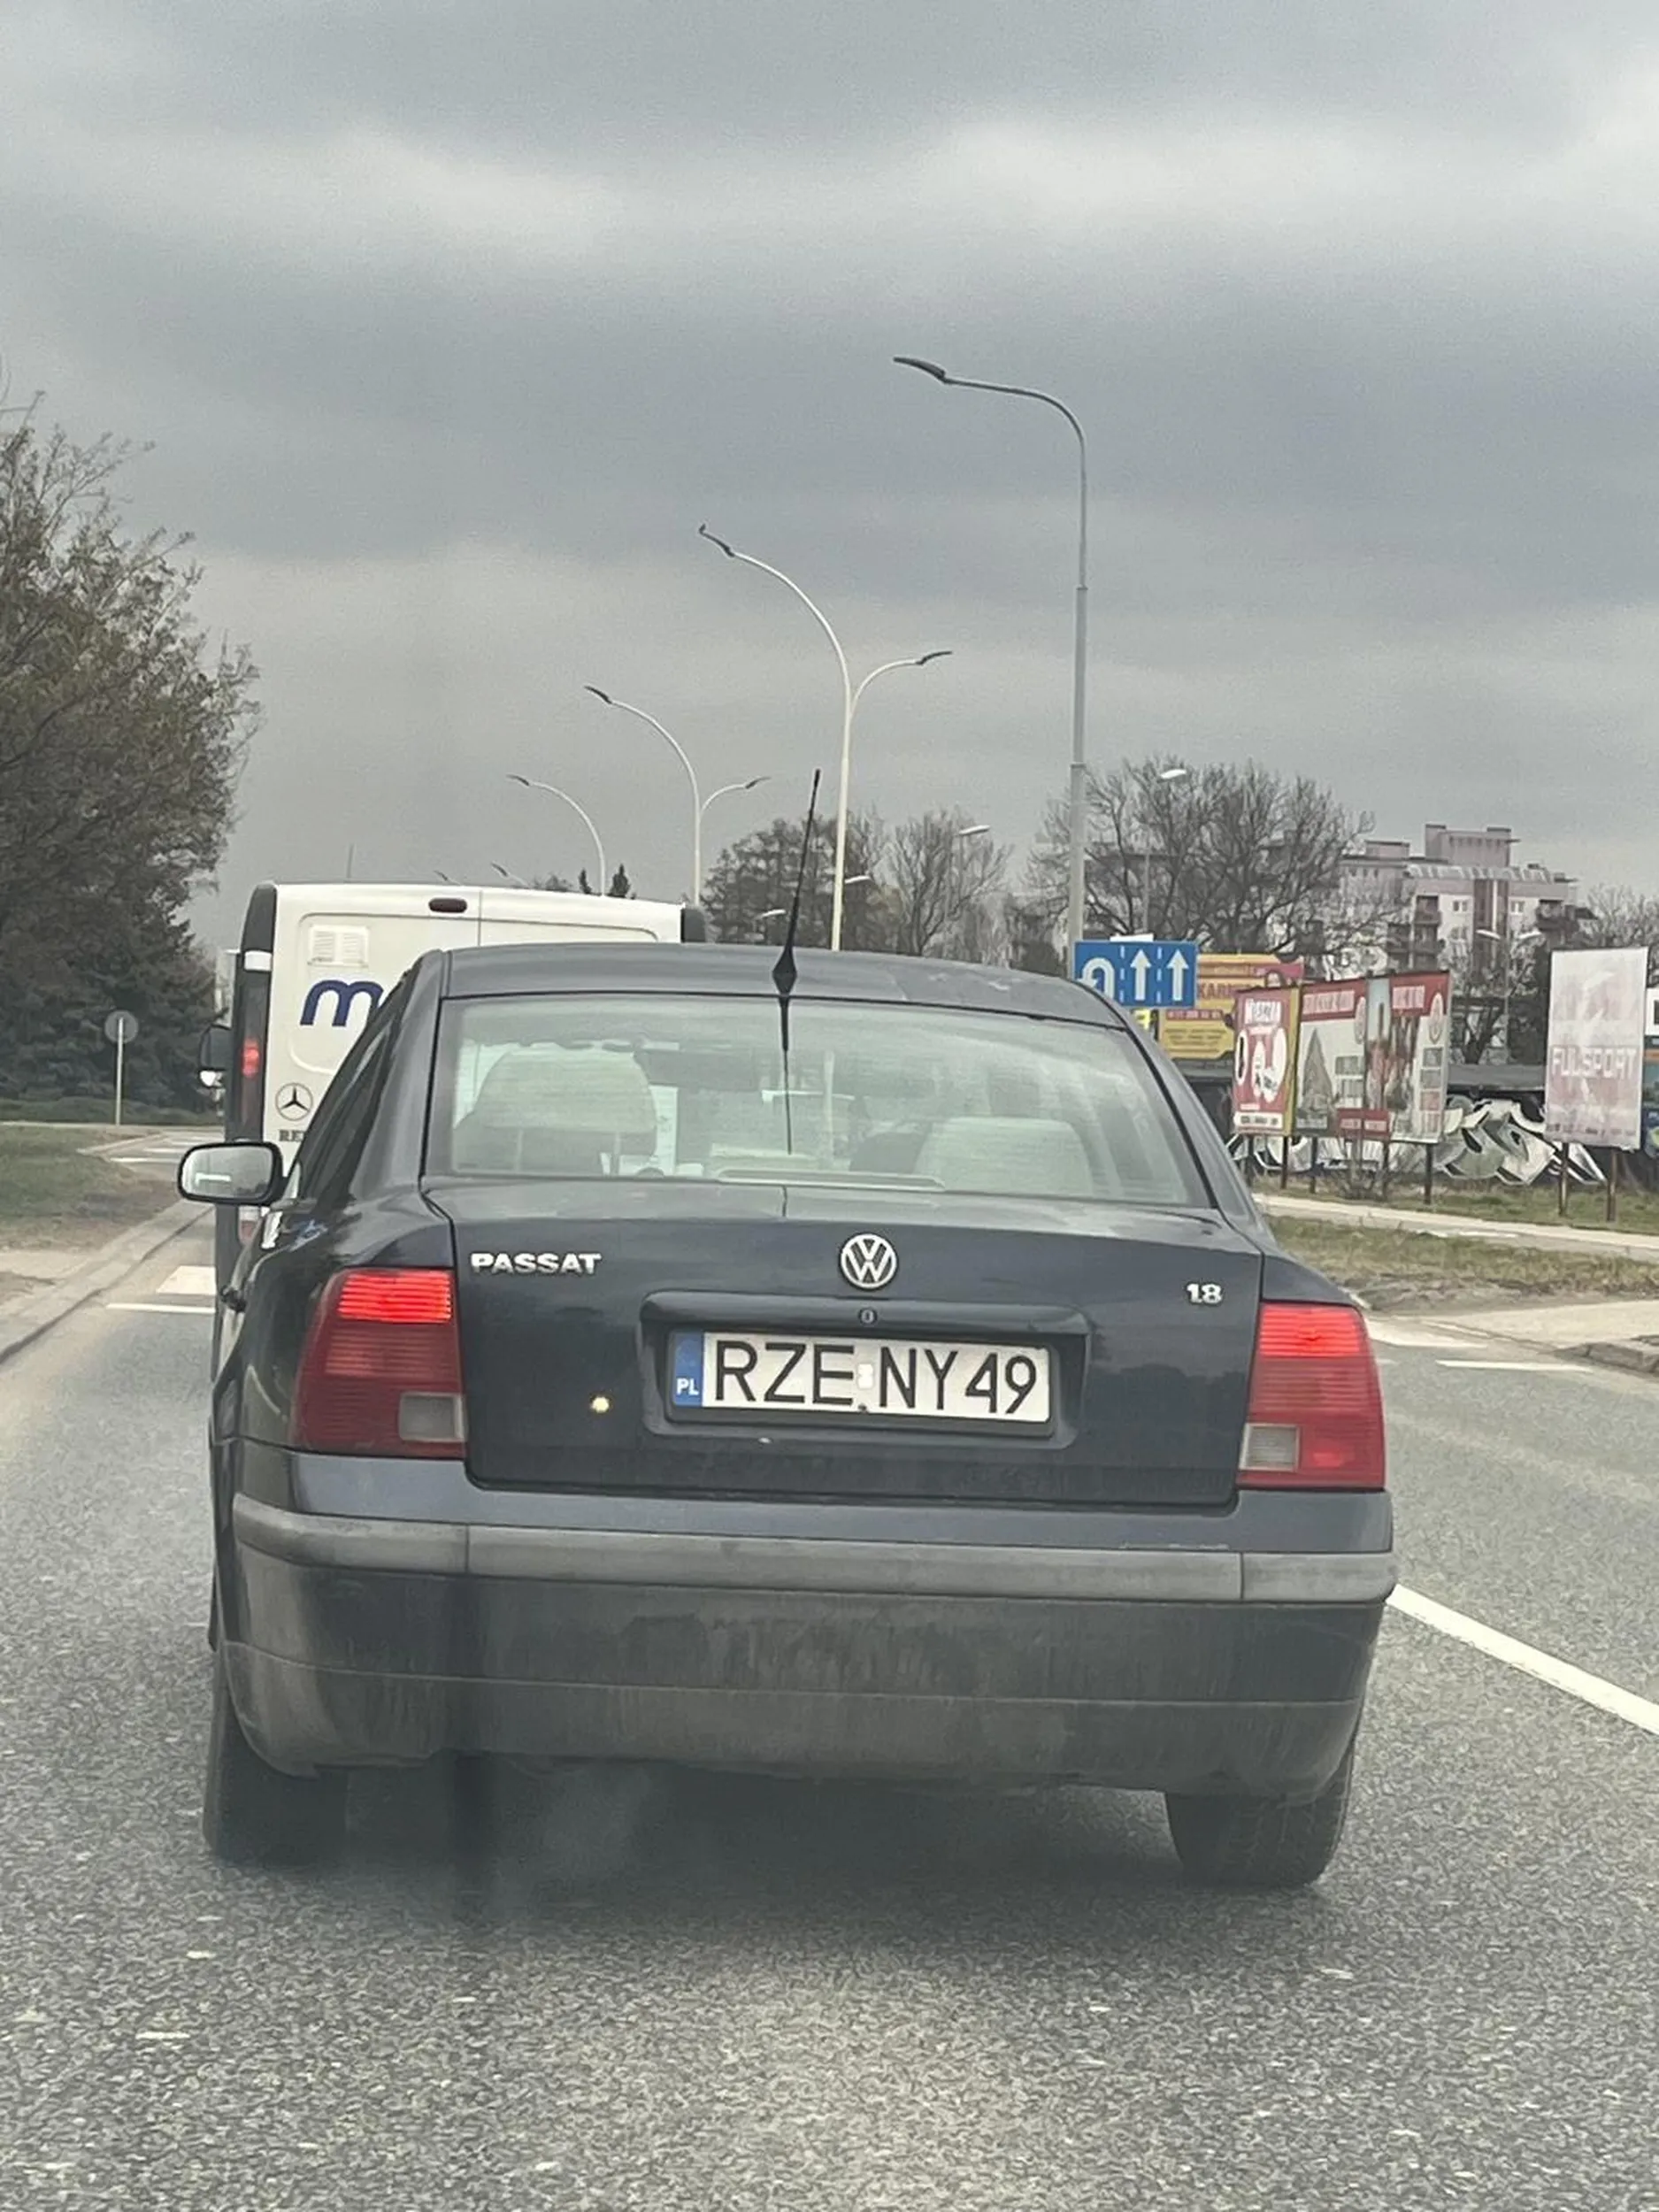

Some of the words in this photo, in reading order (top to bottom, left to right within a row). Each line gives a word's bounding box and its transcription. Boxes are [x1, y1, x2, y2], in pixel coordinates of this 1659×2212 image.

[279, 1129, 306, 1141] RE
[471, 1253, 602, 1274] PASSAT
[715, 1340, 855, 1406] RZE
[879, 1346, 1036, 1414] NY49
[676, 1378, 699, 1396] PL
